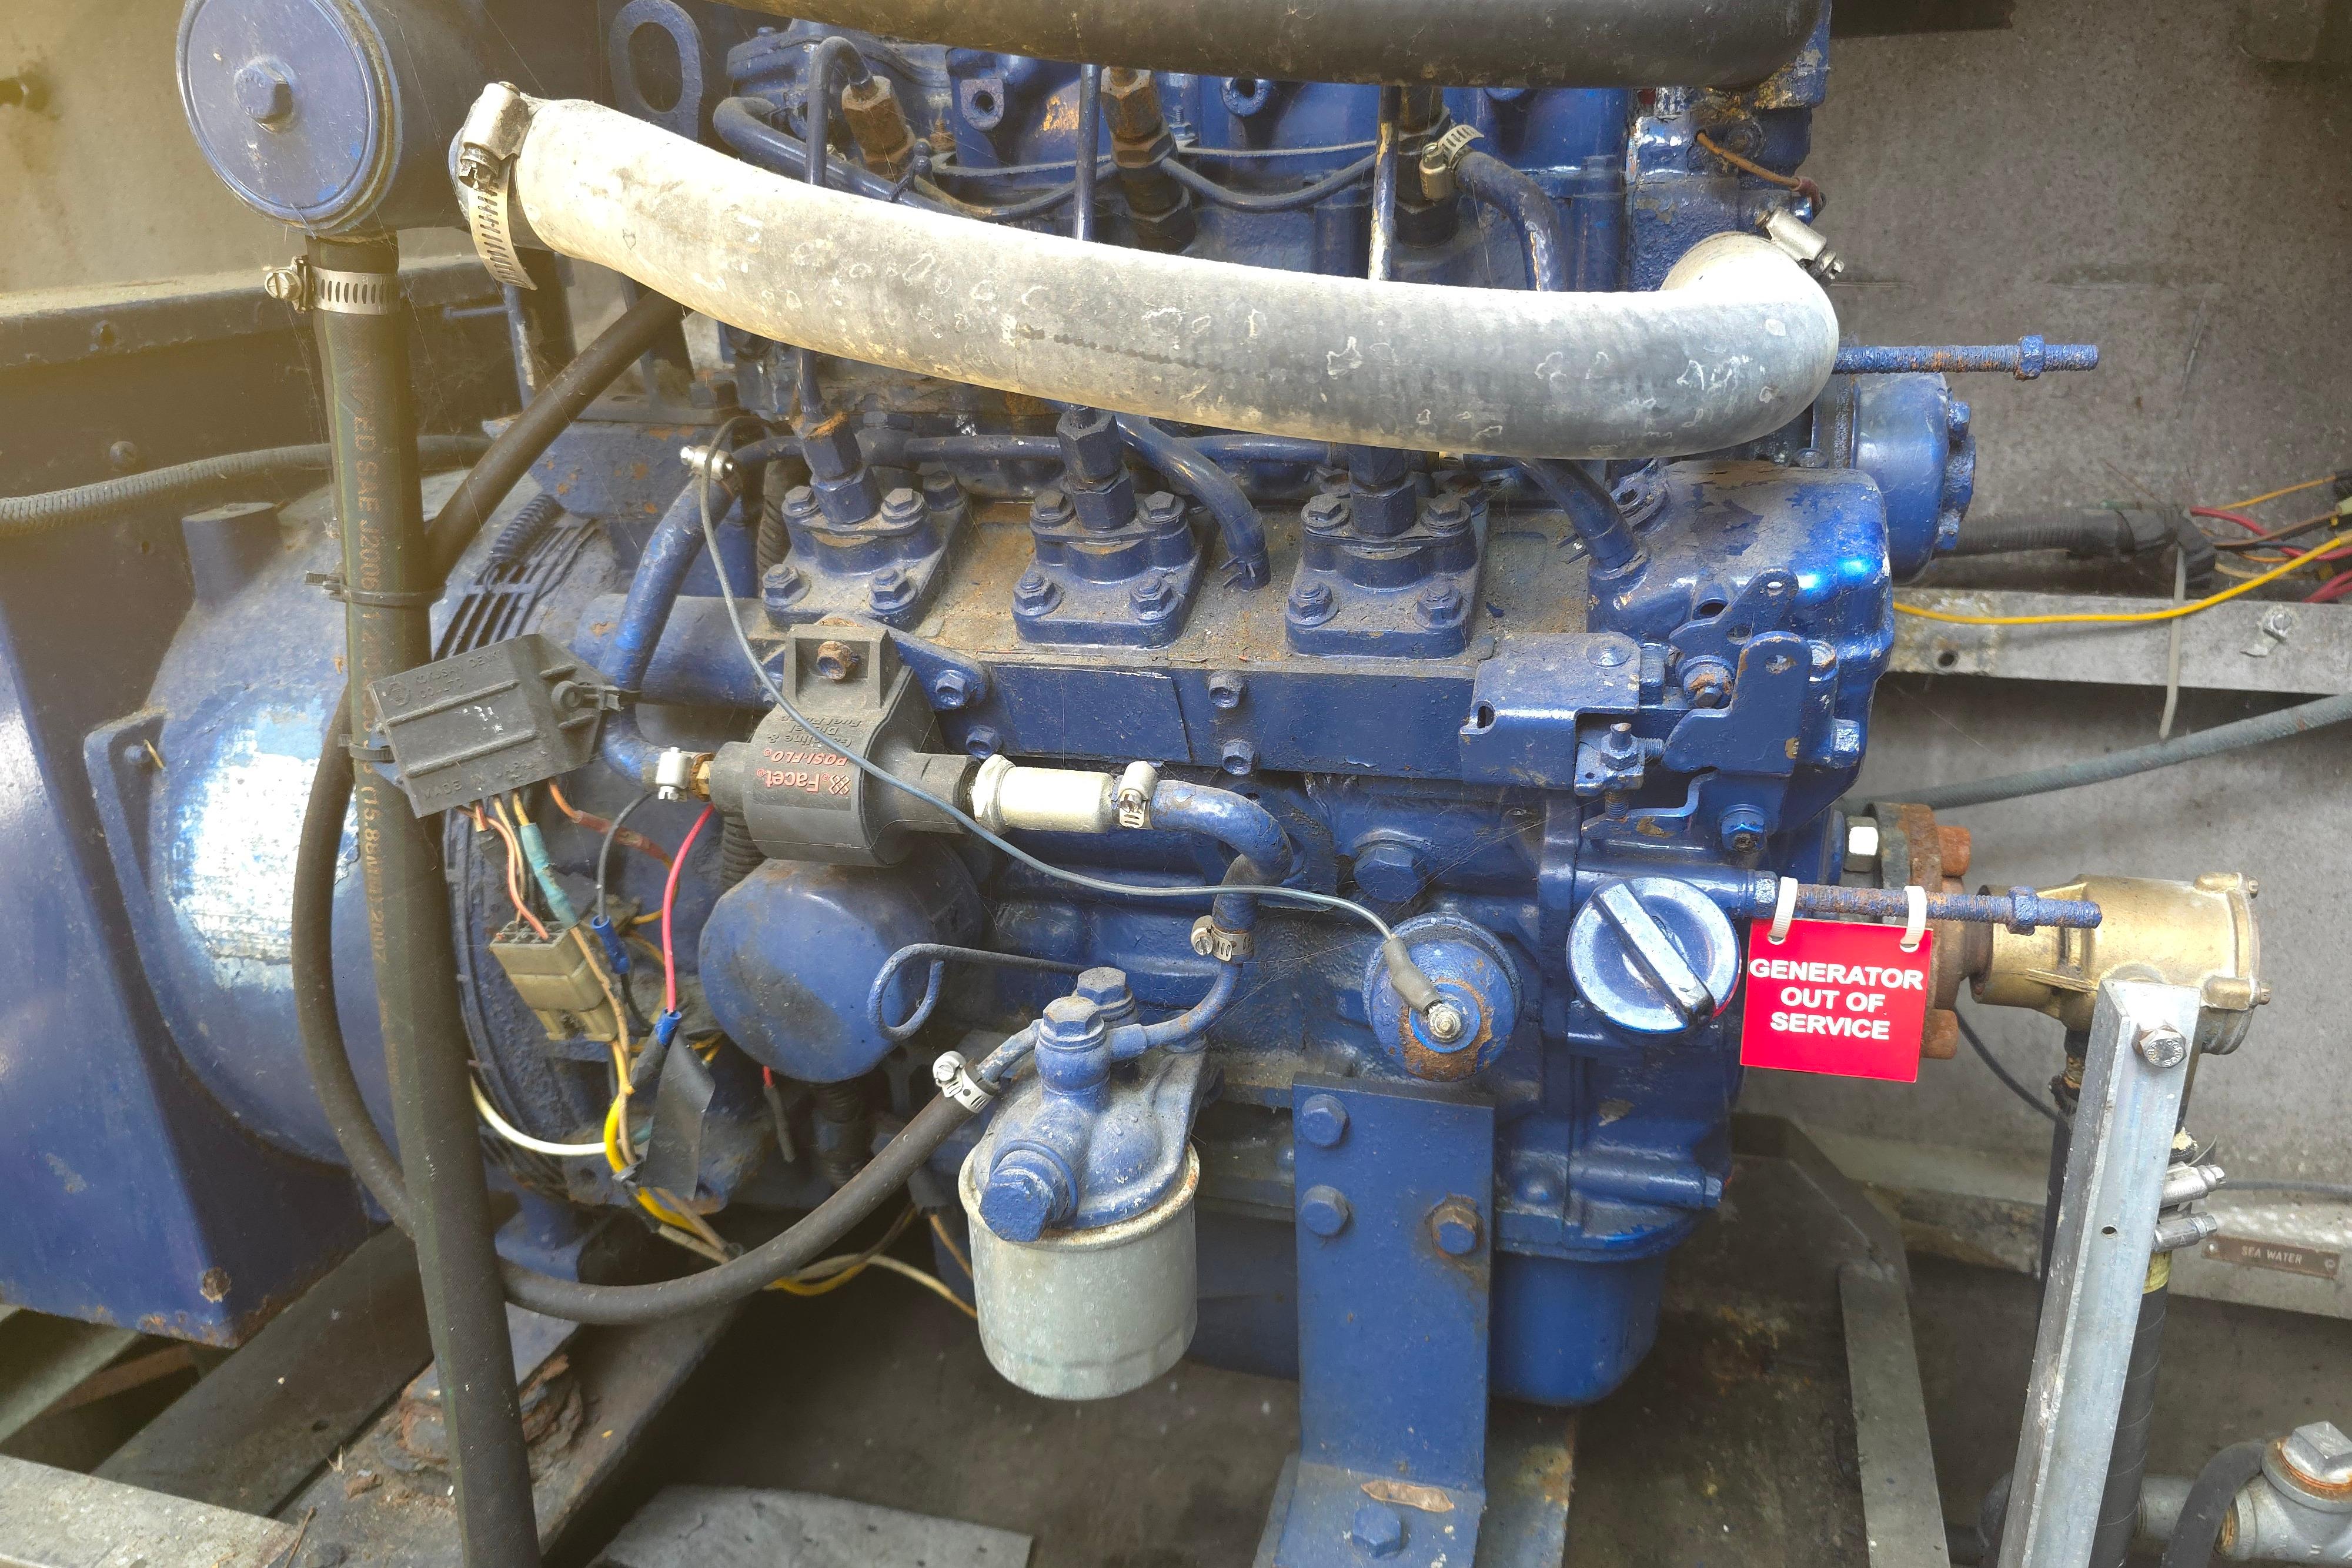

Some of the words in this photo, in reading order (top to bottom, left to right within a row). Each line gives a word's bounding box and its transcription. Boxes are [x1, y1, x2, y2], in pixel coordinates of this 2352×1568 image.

[767, 733, 780, 744] &
[1749, 958, 1924, 990] GENERATOR
[1780, 987, 1840, 1009] OUT
[1846, 992, 1886, 1013] OF
[1770, 1012, 1890, 1041] SERVICE
[2241, 1245, 2261, 1258] SEA
[2267, 1249, 2302, 1265] WATER
